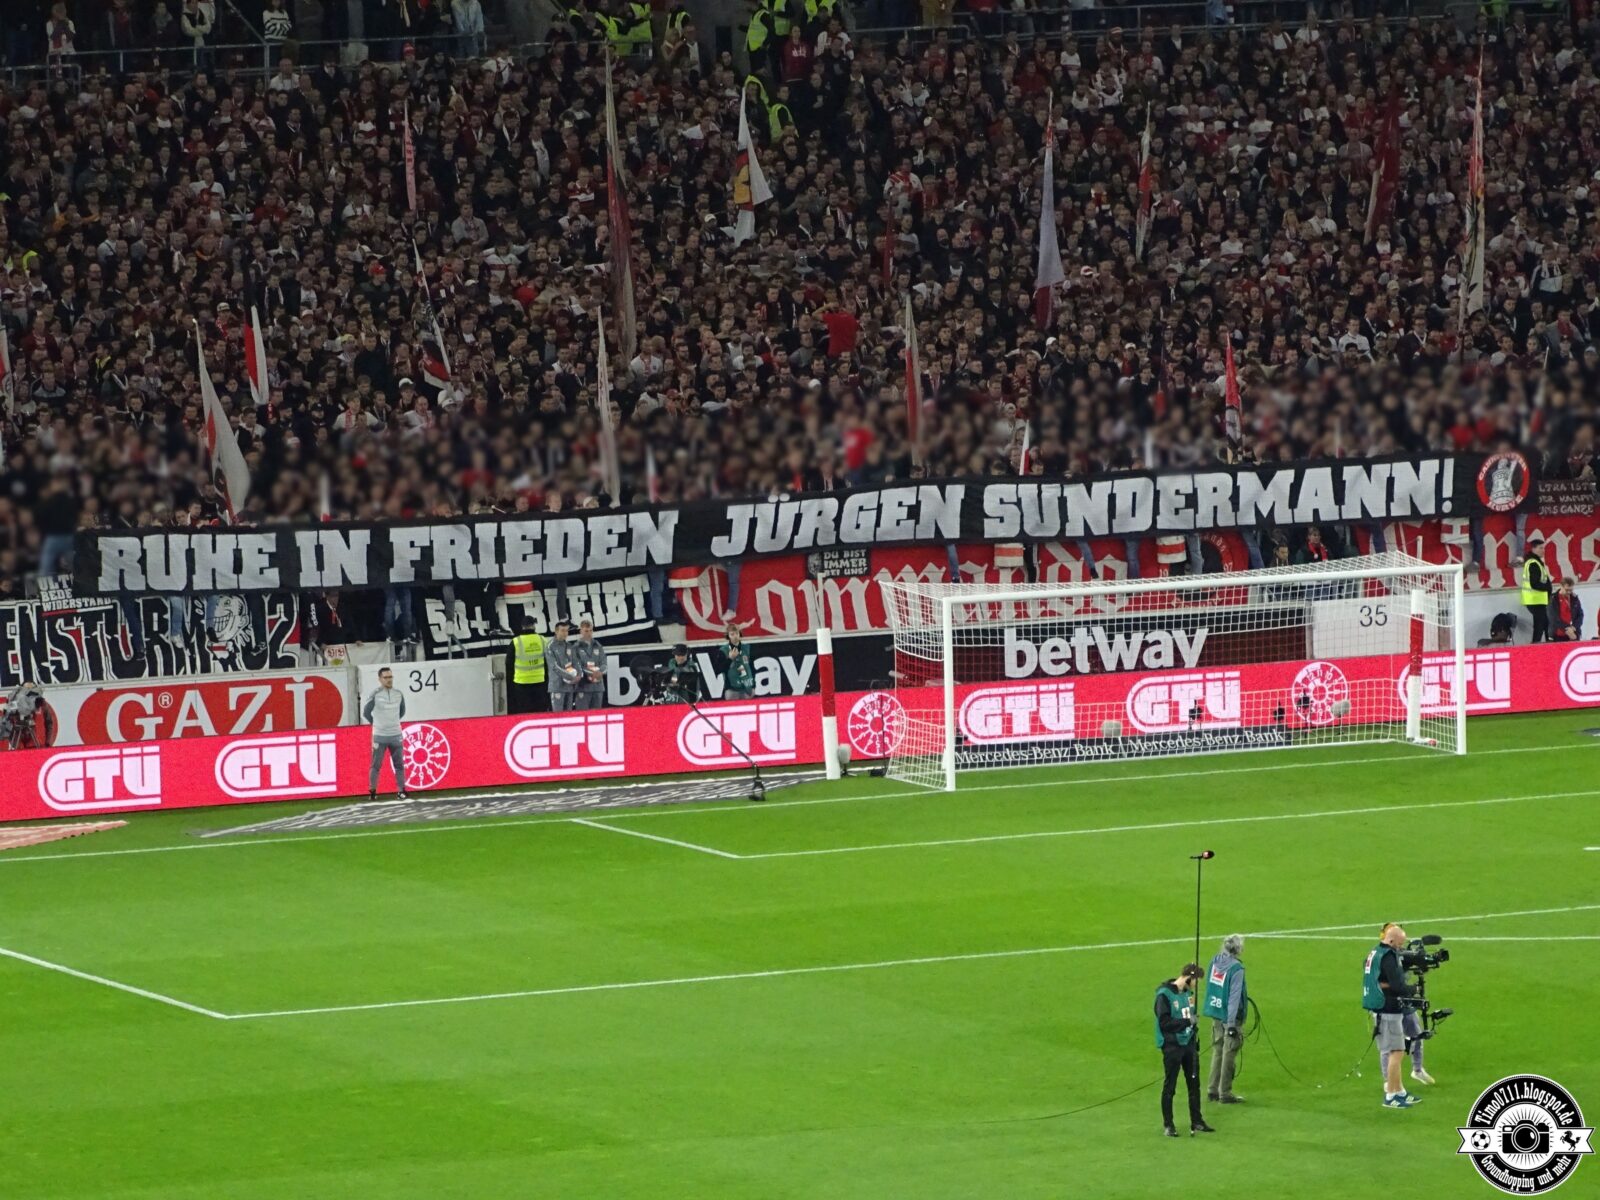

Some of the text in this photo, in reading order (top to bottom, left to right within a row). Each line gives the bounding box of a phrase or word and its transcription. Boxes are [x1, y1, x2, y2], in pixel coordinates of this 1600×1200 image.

[98, 457, 1455, 591] RUHE IN FRIEDEN JÜRGEN SUNDERMANN!
[824, 549, 866, 560] DU BIST
[824, 558, 867, 569] IMMER
[38, 574, 74, 590] ULT
[522, 574, 650, 634] BLEIBT
[1360, 604, 1388, 627] 35
[1004, 626, 1209, 678] betway
[409, 668, 440, 693] 34
[1126, 671, 1241, 733] GTÜ
[678, 703, 797, 766] GTÜ
[959, 683, 1075, 745] GTÜ
[1245, 728, 1285, 743] Bank
[215, 733, 336, 798] GTÜ
[505, 713, 625, 777] GTÜ
[1074, 742, 1113, 757] Bank
[38, 746, 161, 811] GTÜ
[1210, 996, 1222, 1008] 28
